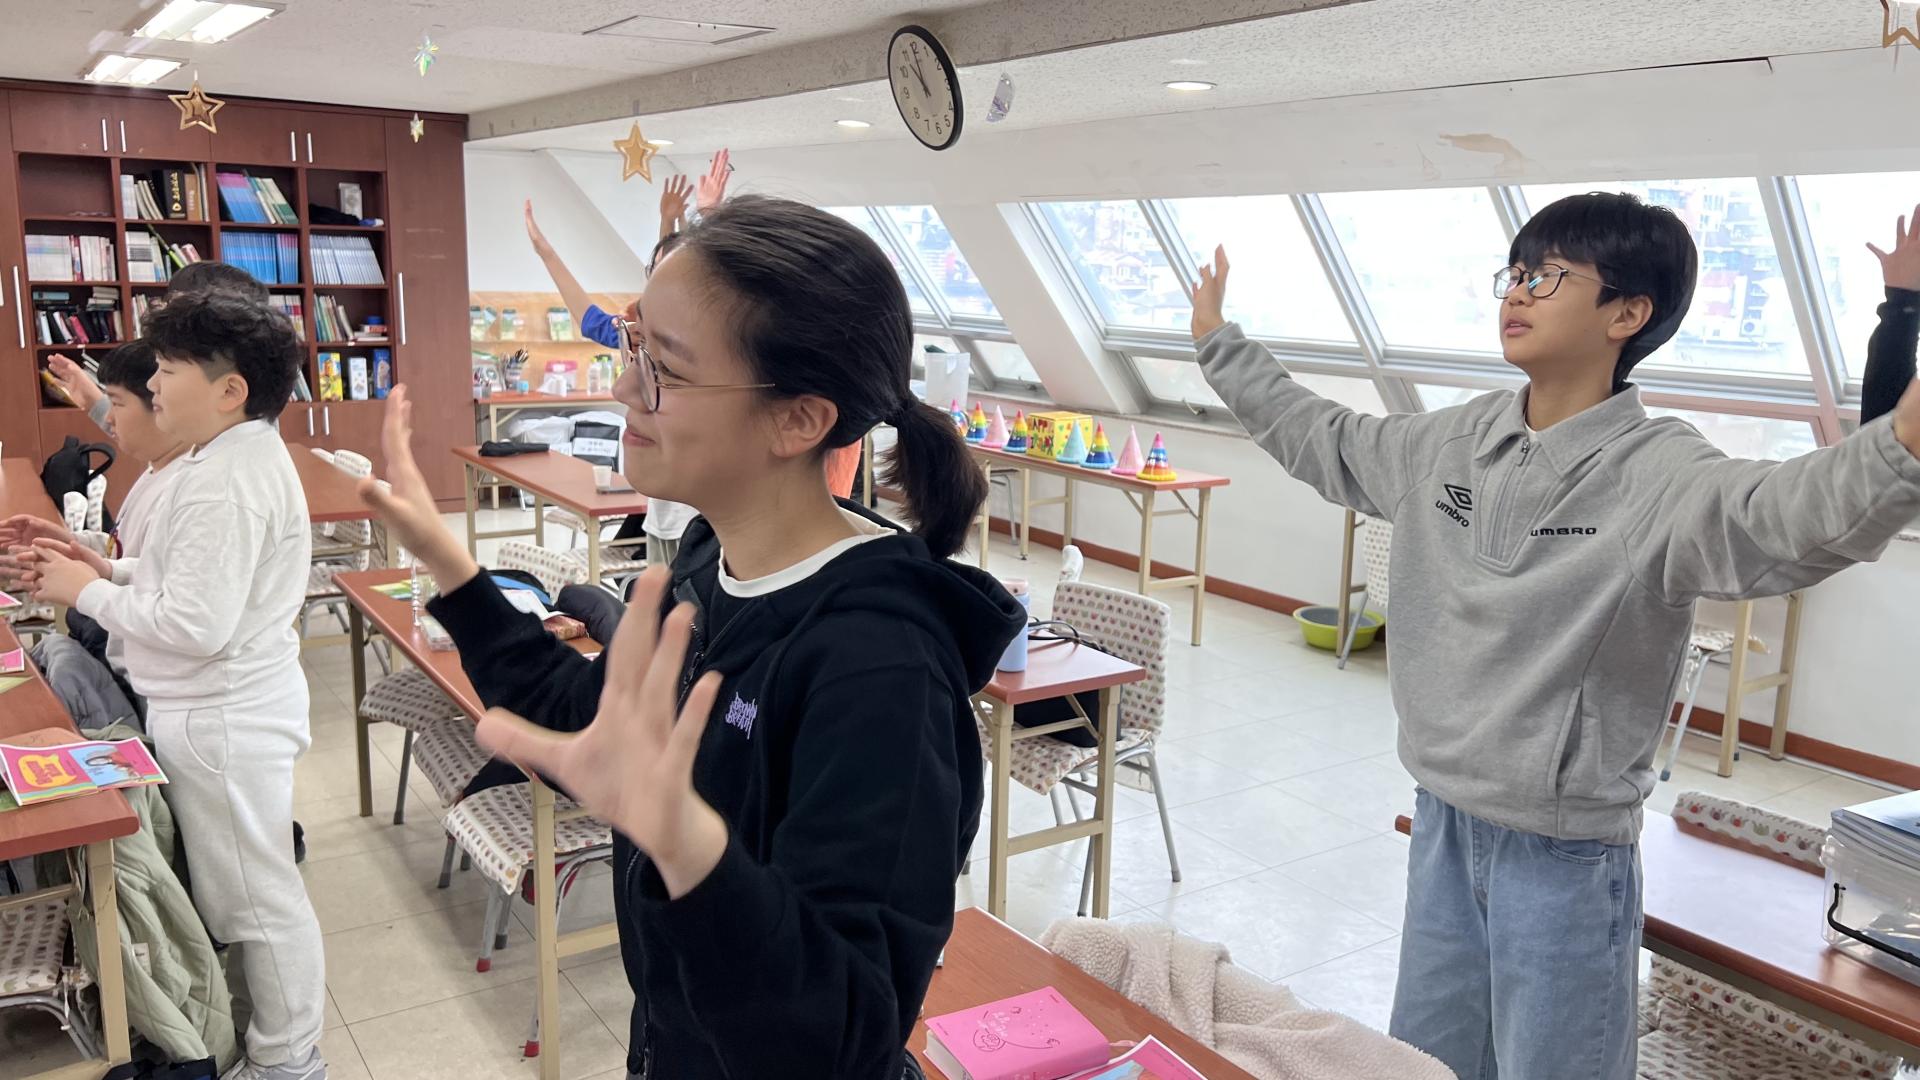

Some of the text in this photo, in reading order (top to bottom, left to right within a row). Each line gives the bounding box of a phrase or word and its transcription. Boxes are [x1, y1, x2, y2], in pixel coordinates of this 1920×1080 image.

[902, 49, 910, 62] 11
[923, 45, 929, 57] 1
[934, 57, 942, 71] 2
[900, 65, 909, 79] 10
[903, 86, 910, 99] 9
[913, 107, 920, 119] 8
[924, 119, 930, 132] 7
[943, 114, 951, 128] 5
[935, 121, 942, 135] 6
[1435, 500, 1470, 528] umbro
